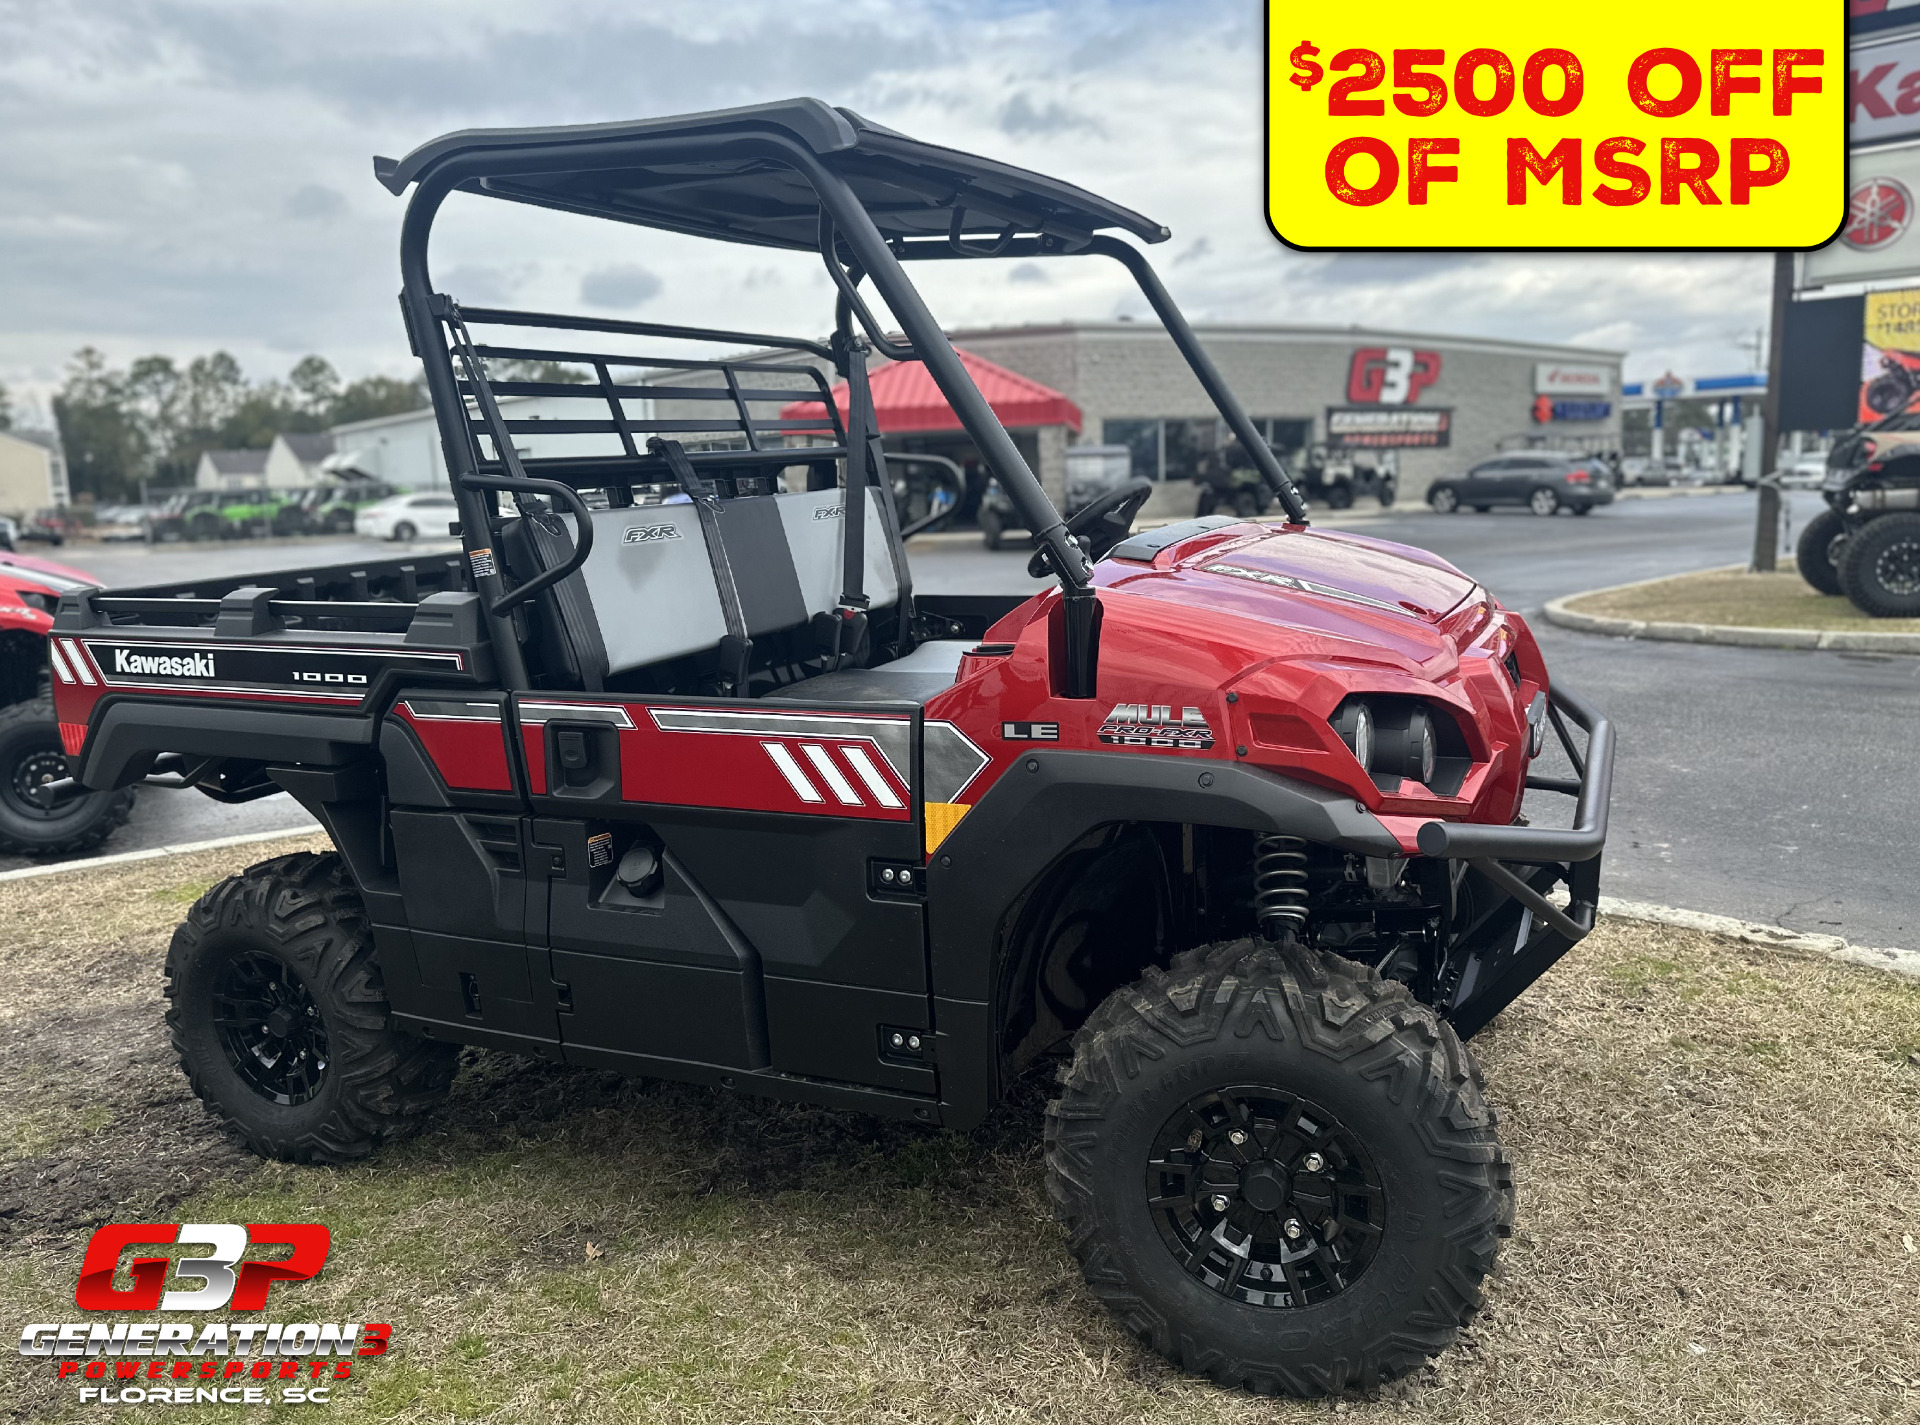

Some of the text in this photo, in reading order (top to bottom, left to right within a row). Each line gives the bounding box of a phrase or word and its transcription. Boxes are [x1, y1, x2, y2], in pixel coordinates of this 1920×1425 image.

[1347, 348, 1442, 405] G3P
[622, 523, 682, 544] FXR
[115, 648, 216, 678] Kawasaki
[292, 671, 368, 684] 1000
[1105, 703, 1211, 728] MULE
[1004, 723, 1058, 739] LE
[1110, 736, 1202, 748] 1000
